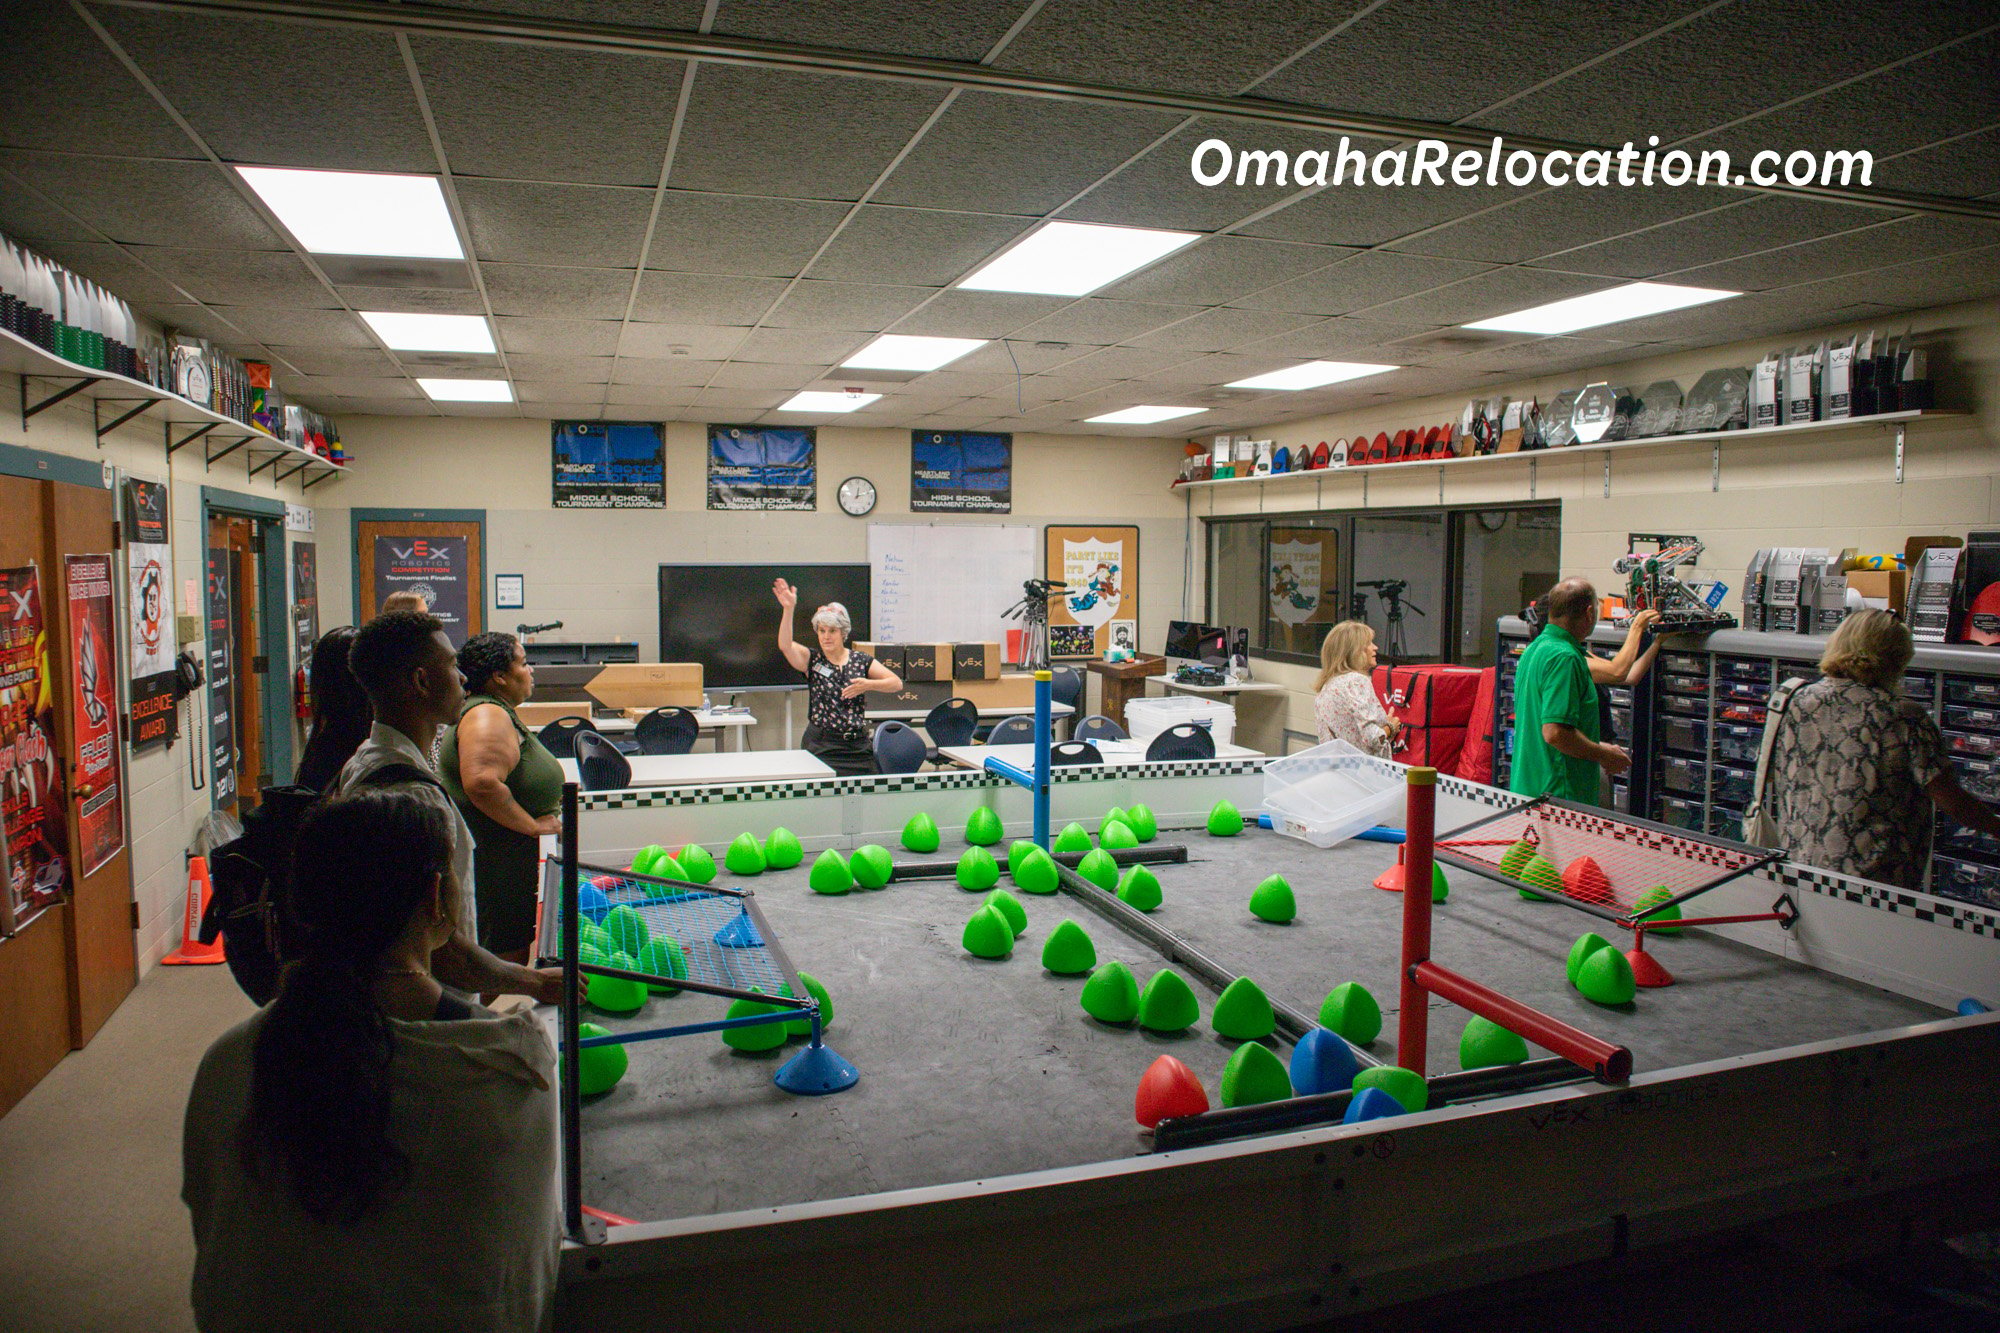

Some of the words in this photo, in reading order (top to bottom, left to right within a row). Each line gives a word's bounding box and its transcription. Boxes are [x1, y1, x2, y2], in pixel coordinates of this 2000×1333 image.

[712, 502, 765, 510] TOURNAMENT
[767, 502, 813, 510] CHAMPIONS
[965, 501, 1010, 509] CHAMPIONS
[391, 540, 451, 560] VEX
[1065, 551, 1096, 561] PARTY
[1097, 551, 1119, 561] LIKE
[1928, 552, 1956, 561] VEX
[1822, 579, 1845, 589] VEX
[908, 658, 934, 669] VEX
[958, 657, 983, 668] VEX
[897, 691, 919, 701] VEX
[131, 692, 174, 721] EXCELLENCE
[139, 717, 166, 742] AWARD
[1529, 1101, 1591, 1131] VEX
